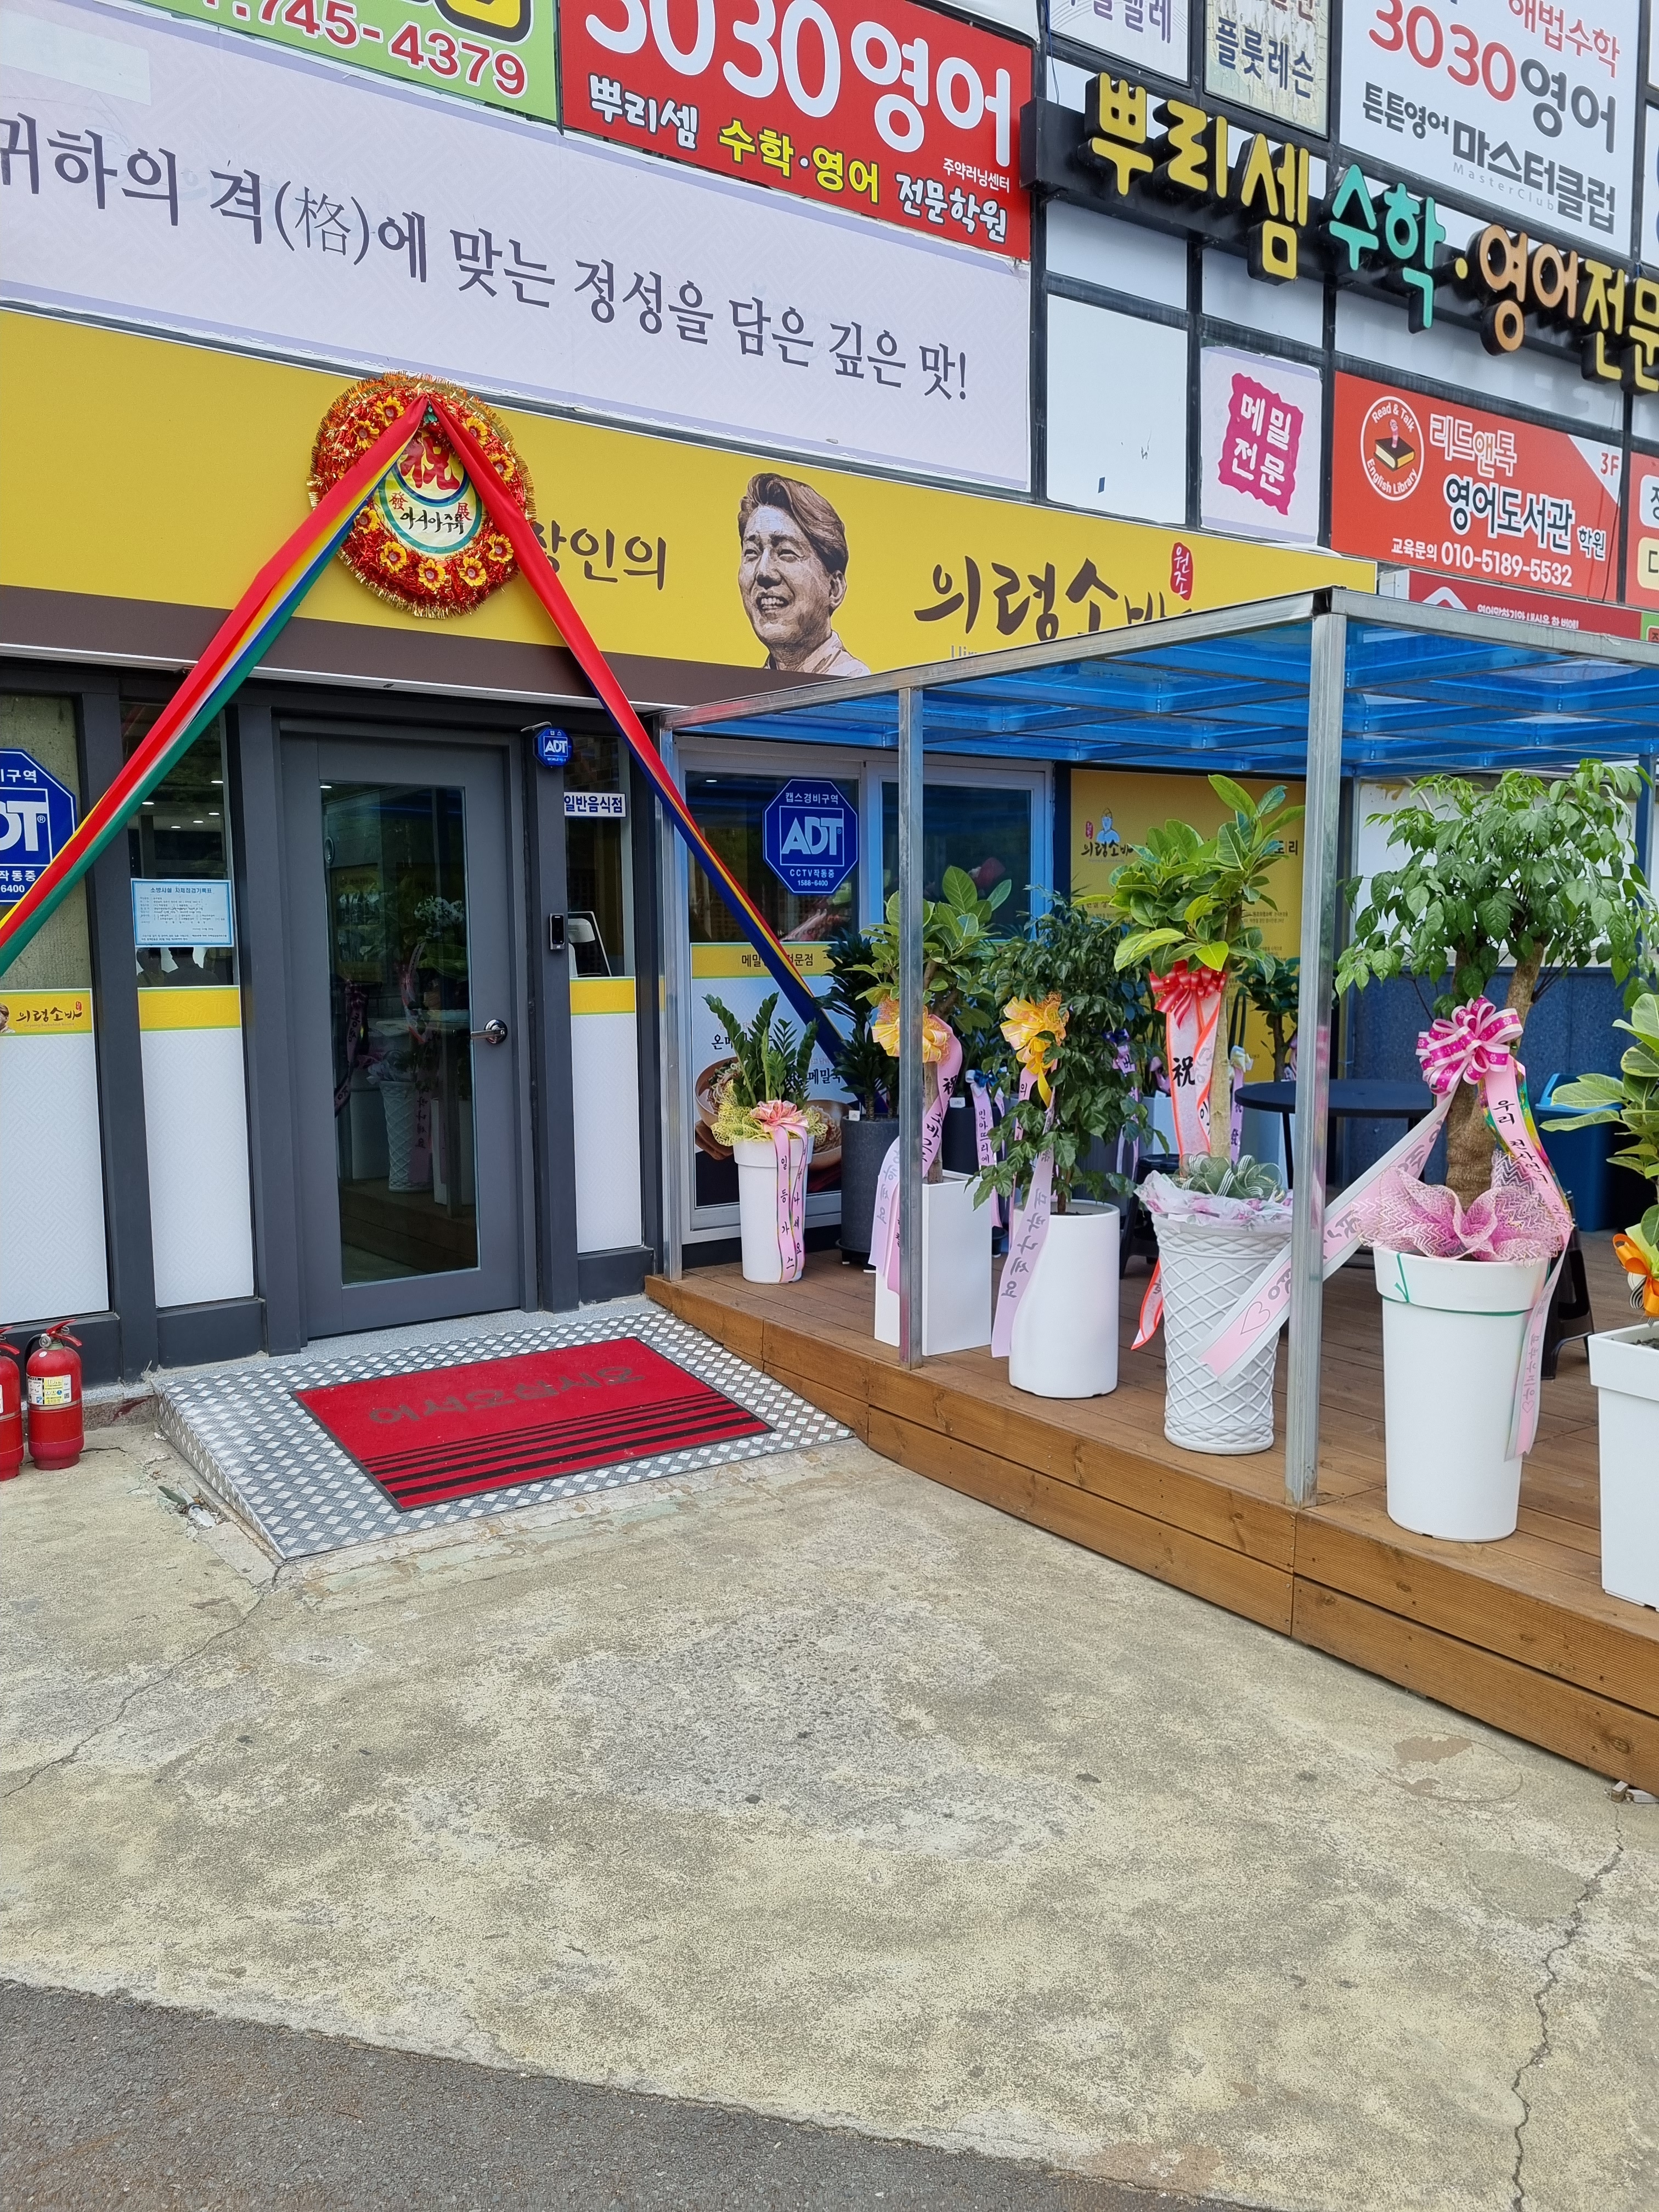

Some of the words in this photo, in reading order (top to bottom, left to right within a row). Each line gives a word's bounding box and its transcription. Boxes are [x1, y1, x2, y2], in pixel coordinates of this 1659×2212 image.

[206, 0, 525, 95] .745-4379
[1369, 0, 1616, 154] 3030영어
[590, 74, 698, 149] 뿌리셈
[896, 174, 1007, 244] 전문학원
[943, 157, 1011, 194] 주약러닝센터
[1363, 81, 1449, 139] 튼튼영어
[1453, 120, 1616, 235] 마스터클럽
[0, 112, 178, 226] 귀하의
[449, 227, 555, 308] 맞는
[574, 258, 714, 345] 정성을
[729, 296, 815, 367] 담은
[828, 321, 907, 388] 깊은
[919, 342, 967, 400] 맛!
[1239, 391, 1294, 446] 메밀
[1372, 404, 1392, 424] Read
[1400, 409, 1417, 433] Talk
[1430, 413, 1517, 478] 리드앤톡
[1600, 452, 1620, 476] 3F
[1232, 437, 1286, 497] 전문
[1367, 458, 1392, 494] English
[1392, 468, 1418, 494] Library
[400, 506, 465, 535] 아시아주류
[1444, 475, 1574, 554] 영어도서관
[1578, 527, 1606, 560] 학원
[1173, 546, 1190, 595] 원조
[1391, 538, 1437, 563] 교육문의
[1441, 541, 1573, 588] 010-5189-5532
[545, 740, 567, 753] ADT
[0, 769, 37, 783] 구역
[563, 795, 623, 814] 일반음식점
[785, 792, 839, 805] 캡스경비구역
[781, 816, 843, 855] ADT
[16, 1006, 83, 1023] 의령소바
[1172, 1056, 1196, 1088] 祝
[1492, 1099, 1515, 1125] 우리
